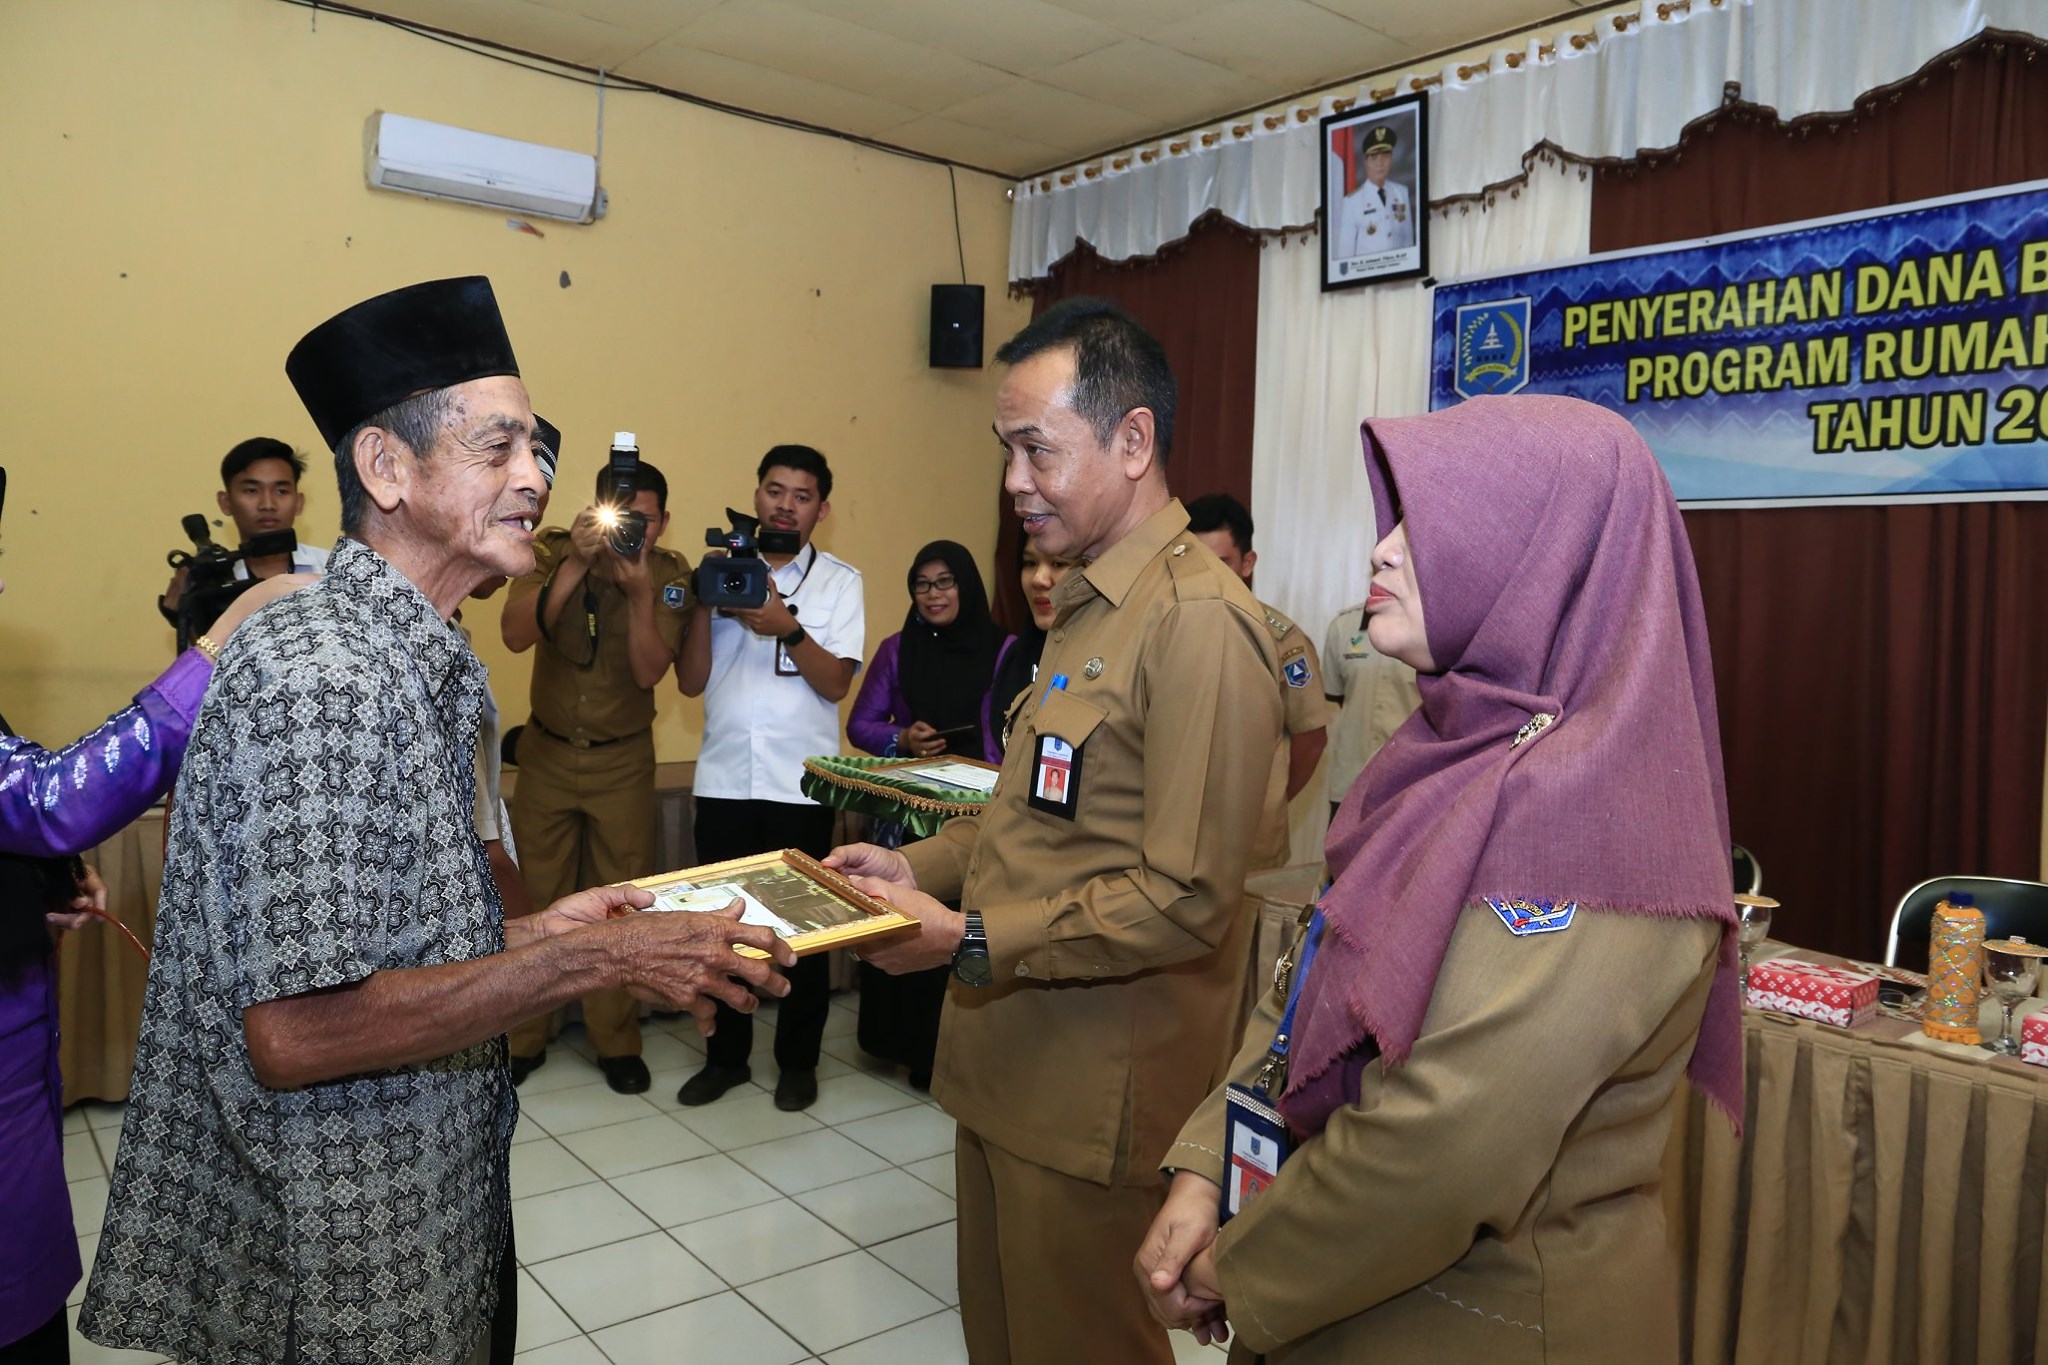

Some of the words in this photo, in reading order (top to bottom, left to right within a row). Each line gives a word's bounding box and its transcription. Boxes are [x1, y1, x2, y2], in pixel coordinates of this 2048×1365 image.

[1564, 270, 1841, 348] PENYERAHAN
[1856, 249, 2004, 314] DANA
[1626, 336, 1849, 400] PROGRAM
[1811, 392, 1983, 450] TAHUN
[1998, 388, 2048, 440] 2
